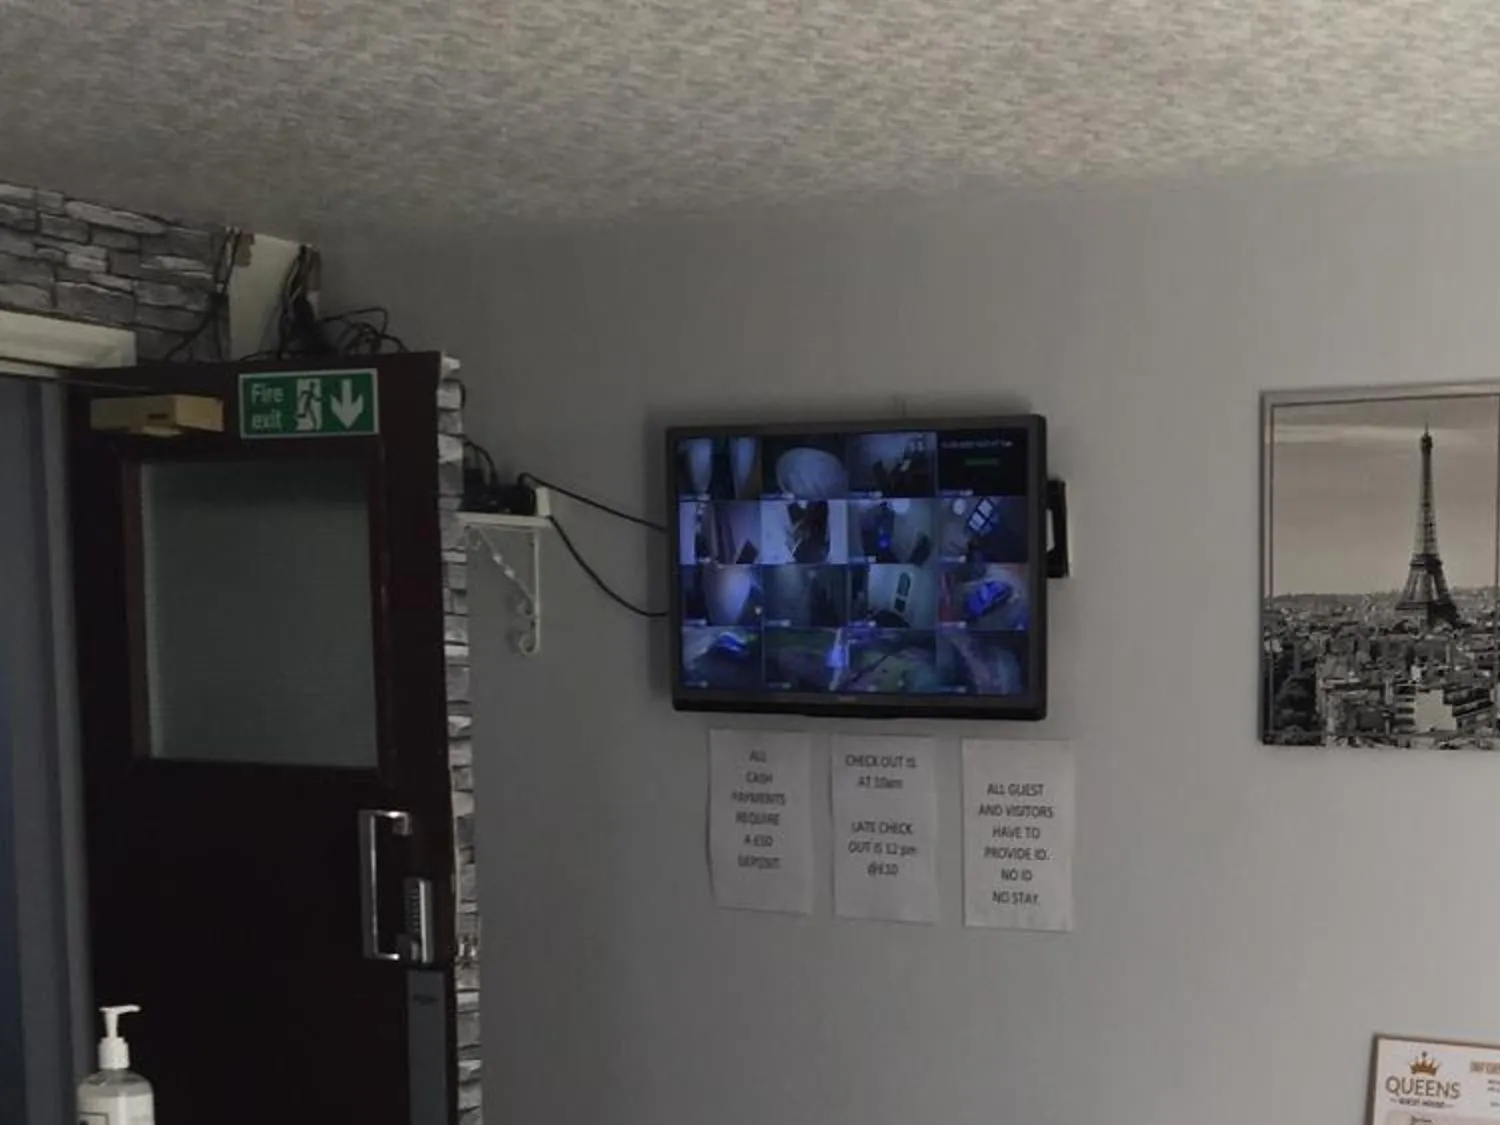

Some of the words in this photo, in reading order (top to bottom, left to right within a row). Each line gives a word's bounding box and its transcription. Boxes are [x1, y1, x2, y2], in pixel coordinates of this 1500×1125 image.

[252, 383, 284, 403] Fire
[252, 410, 282, 429] exit
[749, 750, 767, 763] ALL
[845, 754, 878, 768] CHECK
[880, 756, 904, 769] OUT
[906, 756, 917, 769] IS
[746, 771, 773, 785] CASH
[858, 775, 871, 787] AT
[987, 783, 1005, 795] ALL
[1008, 783, 1044, 796] GUEST
[978, 803, 1003, 816] AND
[1005, 804, 1054, 818] VISITORS
[736, 811, 780, 827] REQUIRE
[851, 821, 876, 833] LATE
[879, 822, 913, 835] CHECK
[992, 826, 1023, 839] HAVE
[1025, 826, 1041, 839] TO
[848, 840, 871, 853] OUT
[983, 846, 1032, 860] PROVIDE
[1001, 868, 1019, 881] NO
[1020, 868, 1033, 881] ID
[992, 890, 1009, 904] NO
[1385, 1075, 1461, 1099] QUEENS
